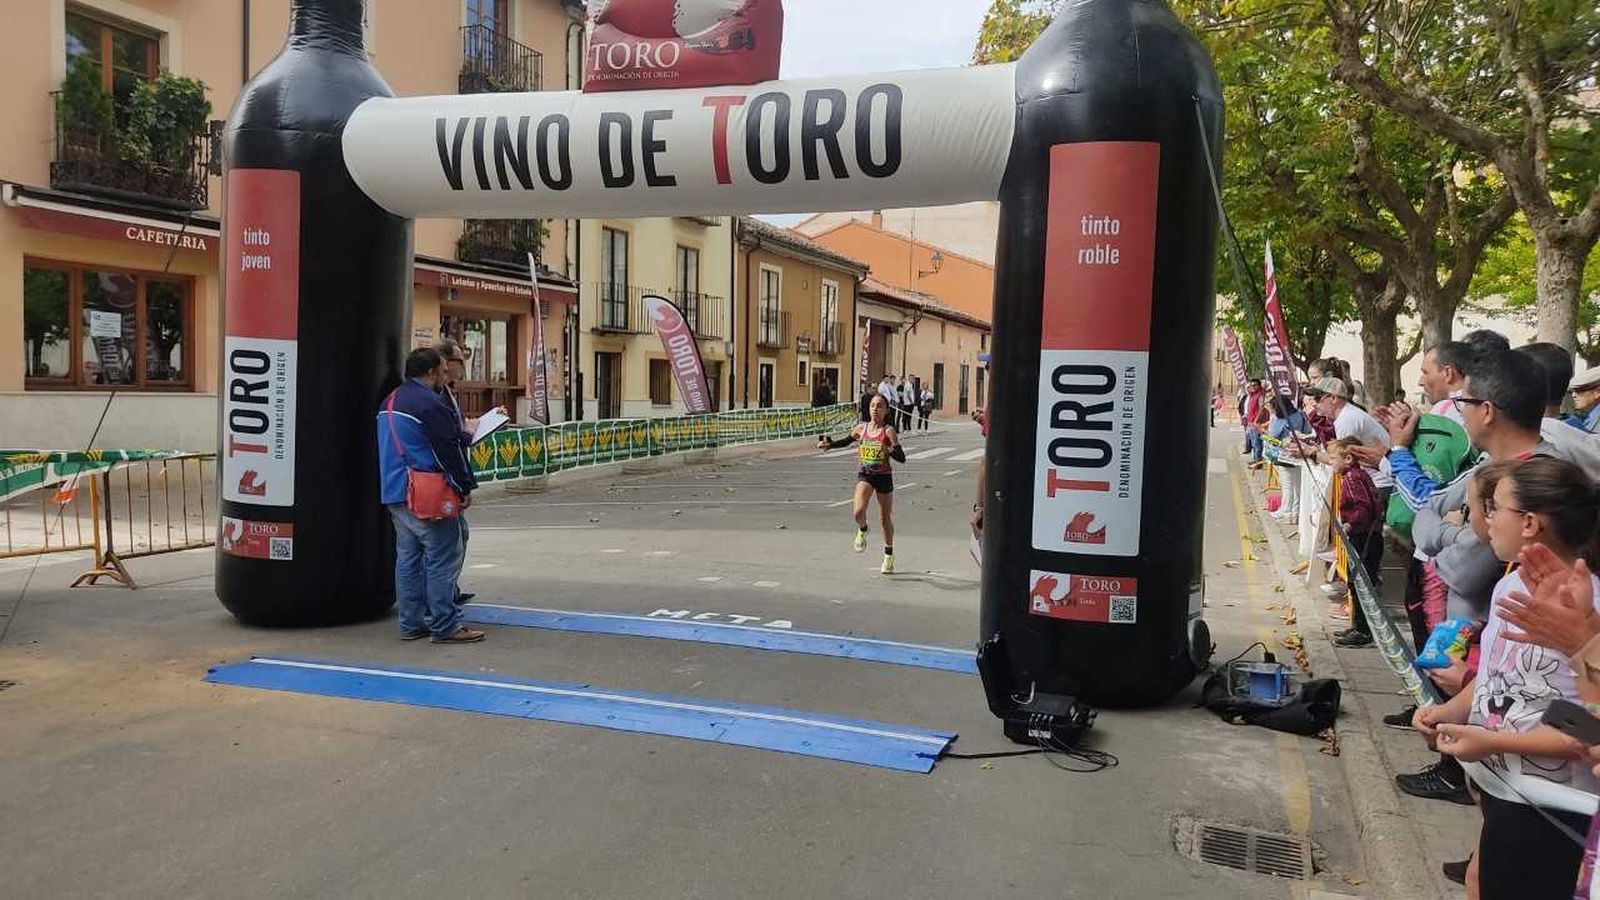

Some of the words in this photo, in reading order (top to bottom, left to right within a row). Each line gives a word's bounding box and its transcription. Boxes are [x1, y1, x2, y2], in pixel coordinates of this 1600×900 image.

[591, 41, 680, 71] TORO
[435, 113, 574, 191] VINO
[599, 109, 678, 188] DE
[702, 82, 903, 185] TORO
[1081, 214, 1120, 236] tinto
[243, 227, 270, 246] tinto
[241, 251, 271, 271] joven
[1078, 243, 1120, 265] roble
[276, 352, 286, 383] ORIGEN
[276, 384, 286, 395] DE
[1123, 366, 1136, 402] ORIGEN
[1278, 379, 1293, 396] DE
[229, 349, 271, 458] TORO
[1122, 407, 1134, 419] DE
[1046, 364, 1116, 498] TORO
[1118, 423, 1133, 499] DENOMINACIÓN
[250, 523, 279, 534] TORO
[1080, 578, 1121, 591] TORO
